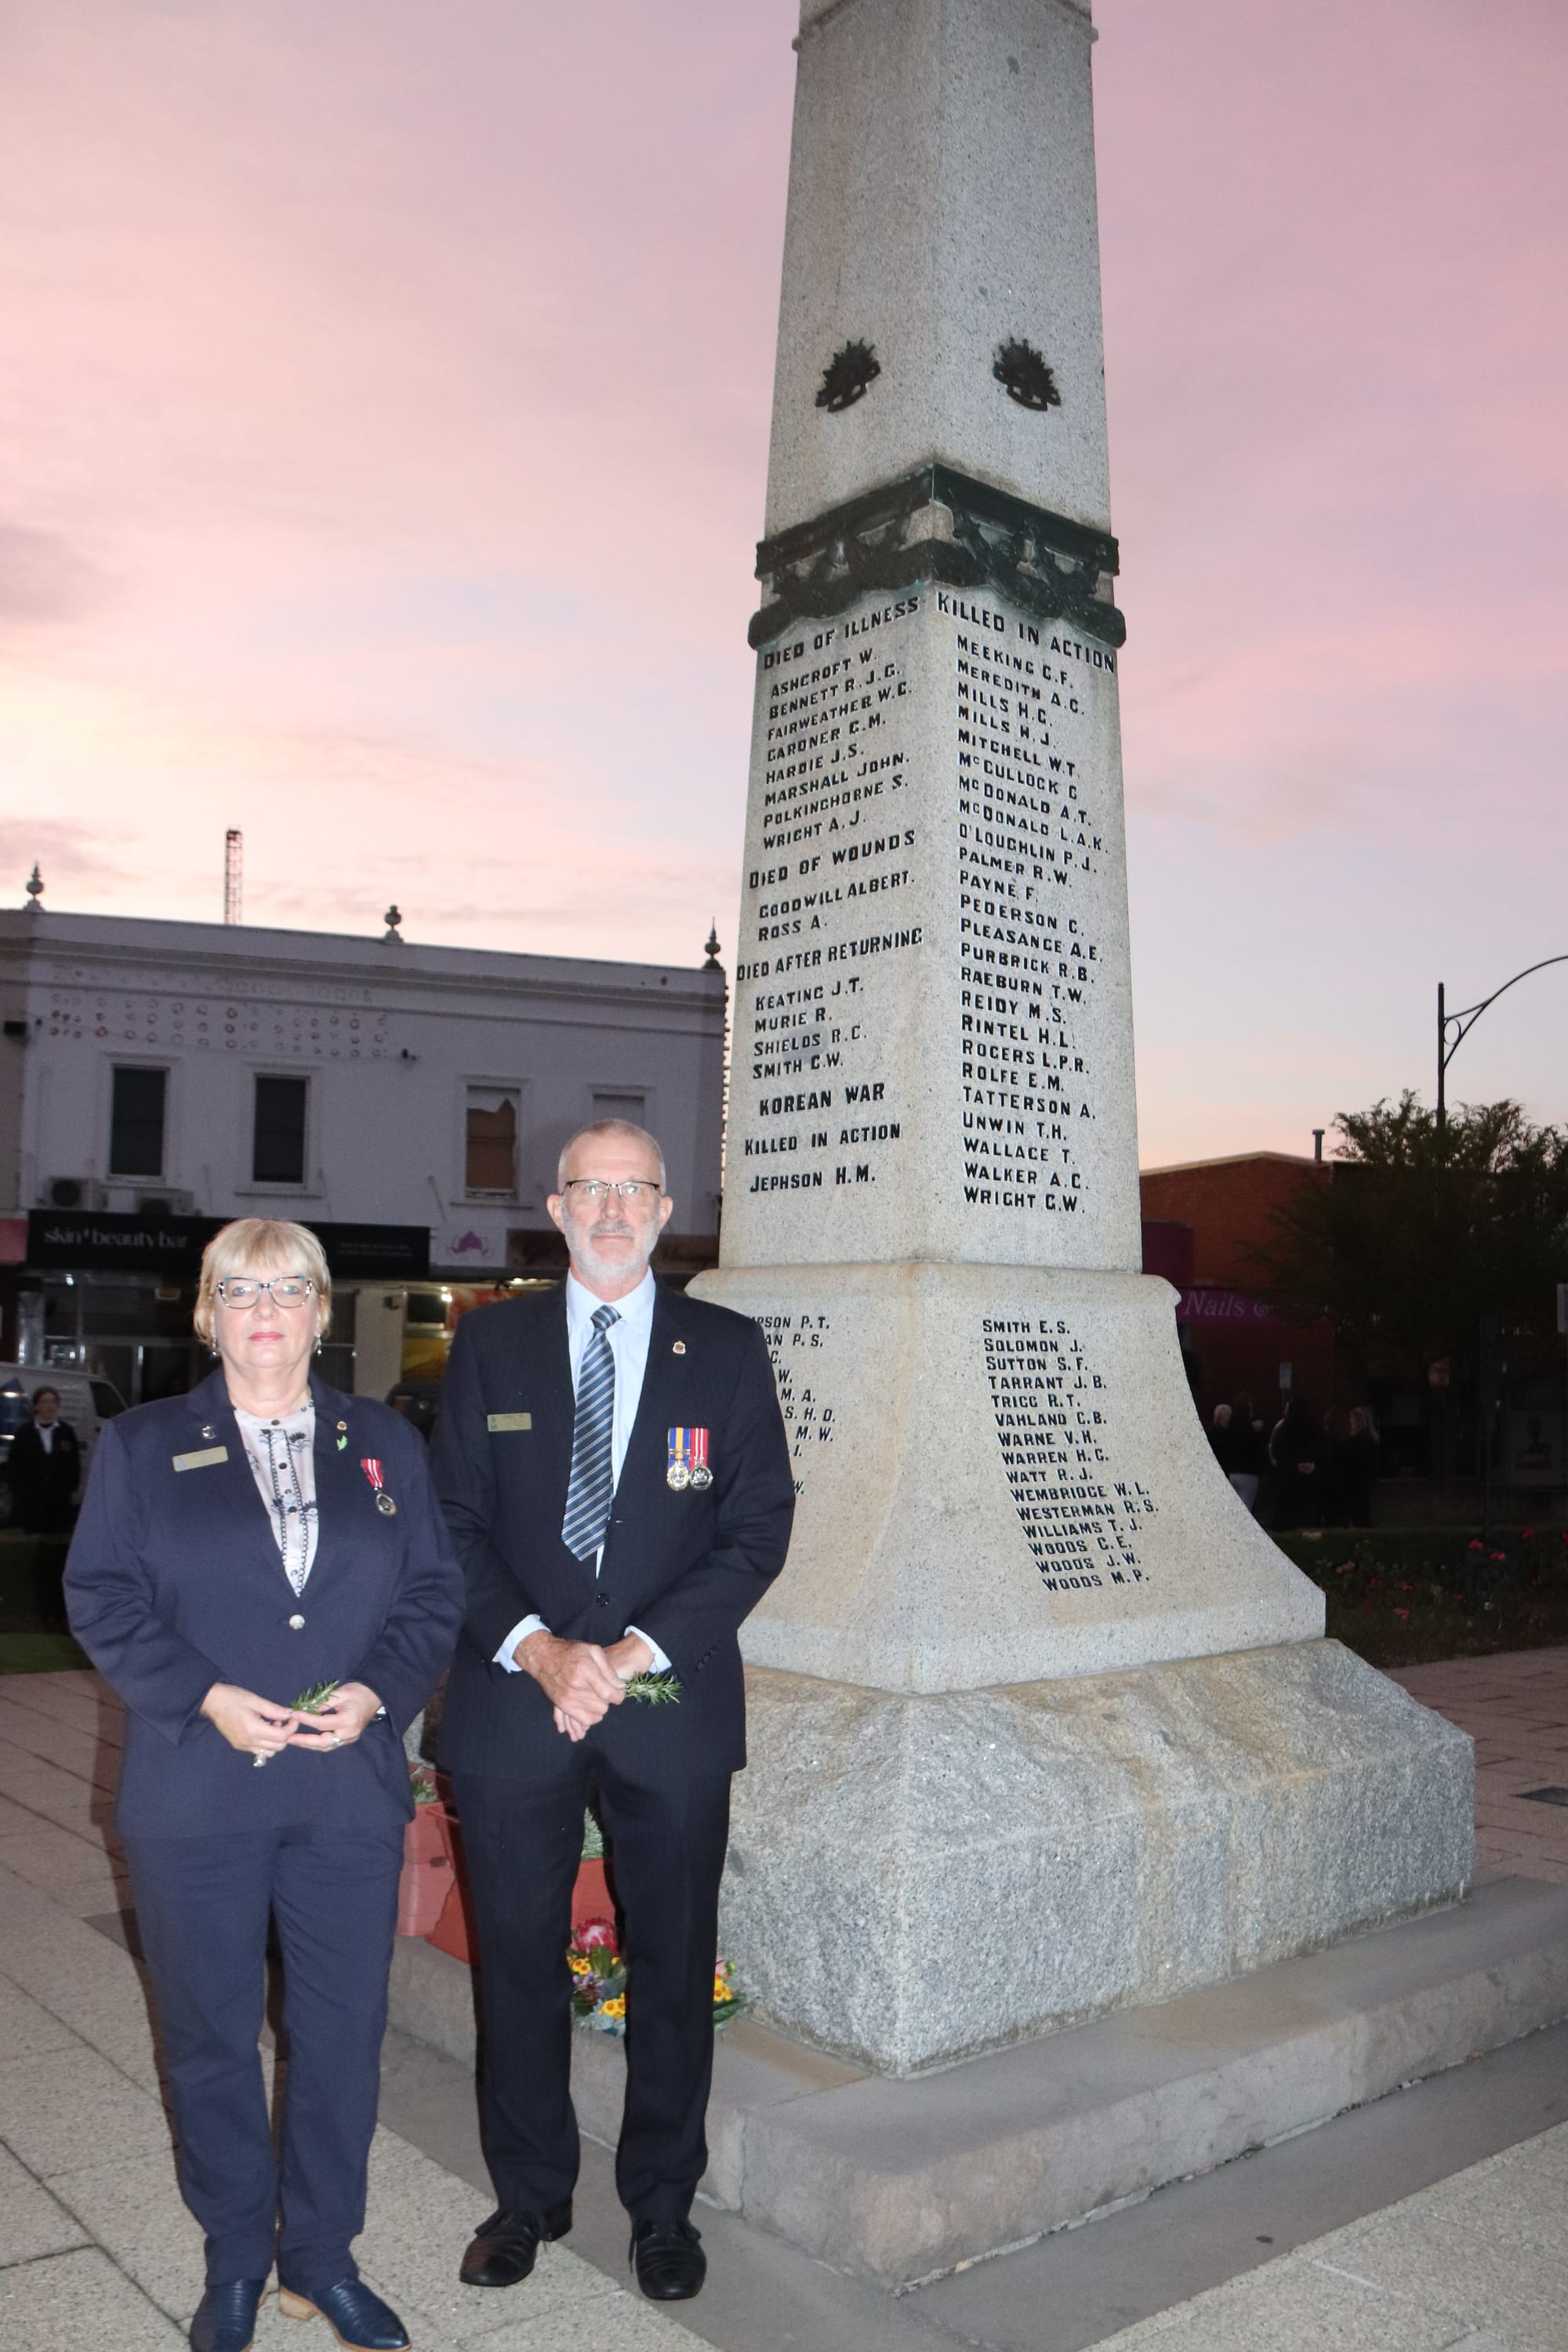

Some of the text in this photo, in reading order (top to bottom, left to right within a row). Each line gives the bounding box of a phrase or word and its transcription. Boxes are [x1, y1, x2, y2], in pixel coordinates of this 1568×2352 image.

[764, 596, 918, 671] DIED OF ILLNESS
[938, 592, 1113, 673] KILLED IN ACTION
[957, 633, 1034, 675] MEEKING
[771, 658, 851, 699] ASHCROFT
[957, 659, 1040, 700] MEREDITH
[769, 684, 839, 720] BENNETT
[957, 681, 1009, 713] MILLS
[768, 695, 873, 741] FAIRWEATHER
[958, 705, 1010, 734] MILLS
[768, 728, 840, 762] GARDNER
[958, 728, 1041, 767] MITCHELL
[766, 755, 823, 785] HARDIE
[764, 771, 849, 807] MARSHALL
[764, 774, 909, 829] POLKINGHORNE S.
[763, 822, 822, 850] WRIGHT
[959, 822, 1055, 862] O'LOUGHLIN
[749, 829, 915, 890] DIED OF WOUNDS
[959, 846, 1025, 876] PALMER
[960, 869, 1038, 902] PAYNE F.
[759, 887, 843, 919] GOODWILL
[960, 893, 1084, 937] PEDERSON C.
[758, 914, 828, 942] ROSS A.
[960, 917, 1062, 954] PLEASANCE
[736, 927, 923, 982] DIED AFTER RETURNING
[961, 942, 1049, 975] PURBRICK
[961, 966, 1042, 996] RAEBURN
[755, 985, 824, 1011] KEATING
[961, 990, 1018, 1015] REIDY
[754, 1007, 833, 1033] MURIE R.
[961, 1014, 1029, 1041] RINTEL
[753, 1033, 821, 1057] SHIELDS
[962, 1038, 1035, 1065] ROGERS
[753, 1058, 802, 1080] SMITH
[962, 1062, 1018, 1086] ROLFE
[759, 1082, 885, 1116] KOREAN WAR
[963, 1085, 1096, 1120] TATTERSON A.
[963, 1111, 1025, 1135] UNWIN
[745, 1123, 901, 1156] KILLED IN ACTION
[964, 1136, 1075, 1165] WALLACE T.
[750, 1171, 822, 1192] JEPHSON
[964, 1161, 1037, 1185] WALKER
[964, 1185, 1036, 1209] WRIGHT
[1184, 1291, 1245, 1318] Nails
[982, 1319, 1031, 1334] SMITH
[983, 1338, 1083, 1352] SOLOMON J.
[985, 1356, 1047, 1370] SUTTON
[988, 1375, 1063, 1389] TARRANT
[990, 1395, 1038, 1408] TRIGG
[994, 1413, 1067, 1427] VAHLAND
[997, 1432, 1055, 1447] WARNE
[1001, 1451, 1068, 1465] WARREN
[1006, 1471, 1047, 1484] WATT
[1010, 1486, 1107, 1502] WEMBRIDGE
[1015, 1504, 1116, 1521] WESTERMAN
[1022, 1521, 1103, 1539] WILLIAMS
[1028, 1540, 1088, 1556] WOODS
[1035, 1558, 1094, 1573] WOODS
[1042, 1574, 1103, 1592] WOODS
